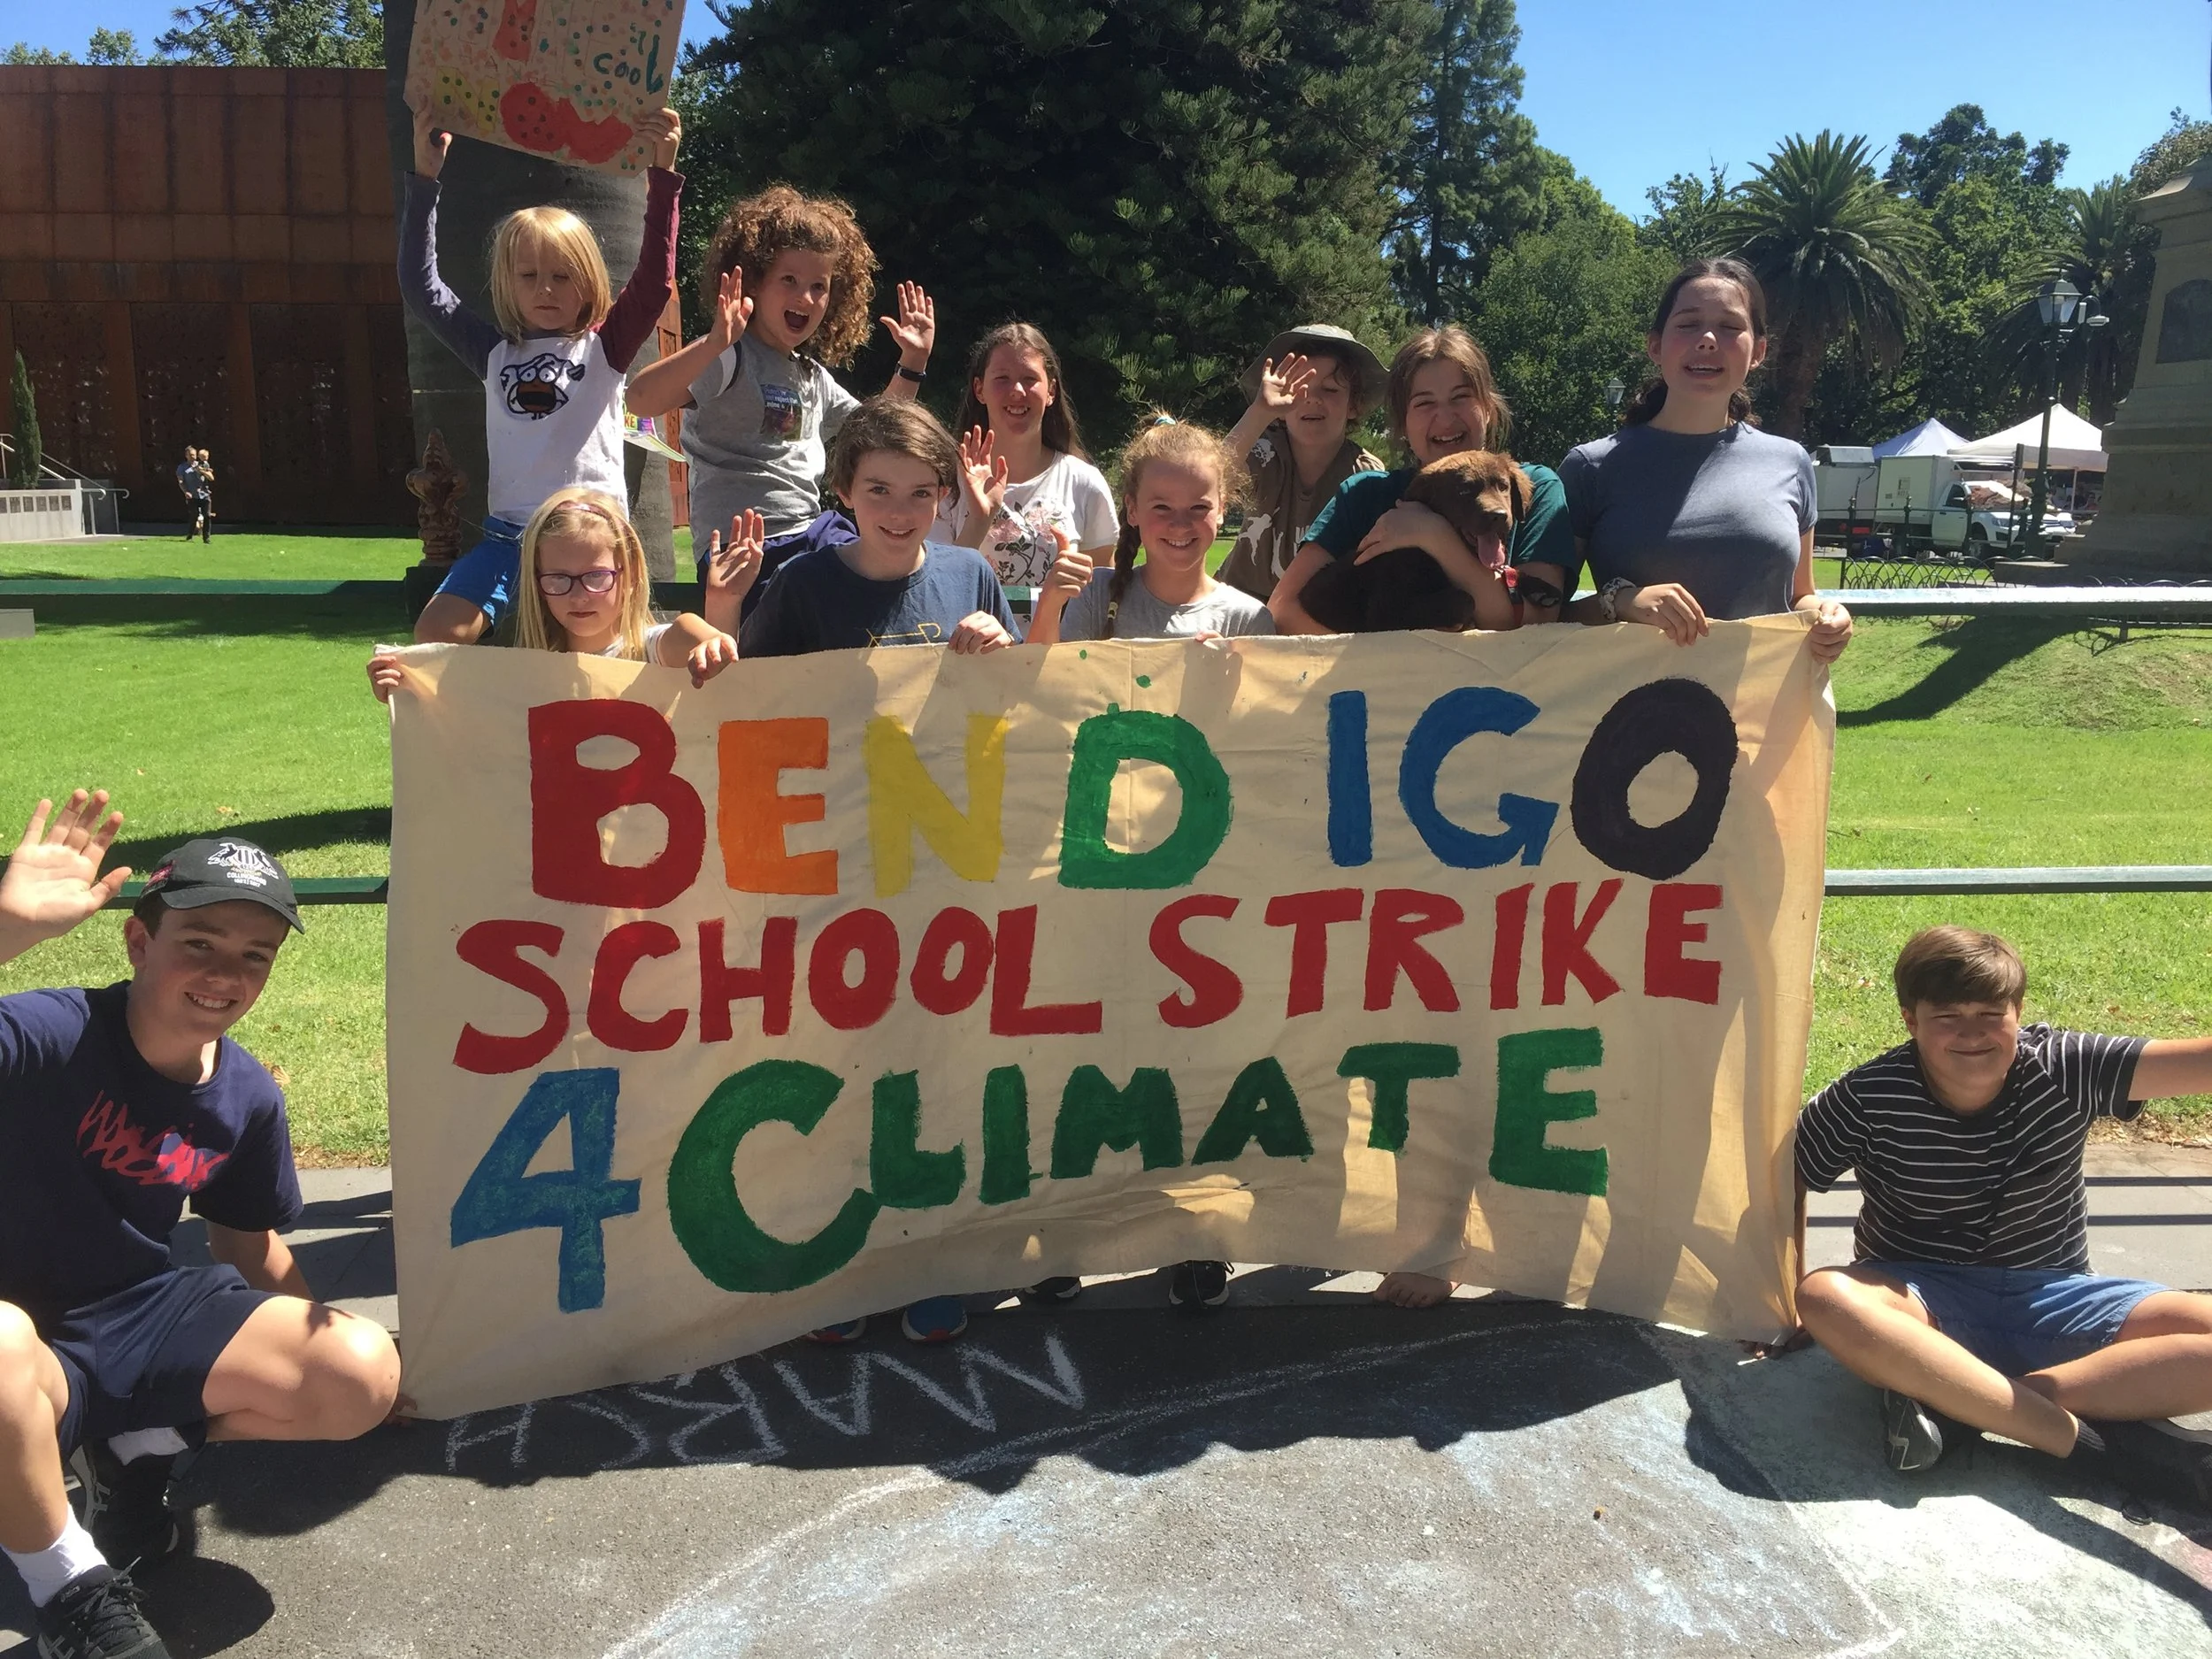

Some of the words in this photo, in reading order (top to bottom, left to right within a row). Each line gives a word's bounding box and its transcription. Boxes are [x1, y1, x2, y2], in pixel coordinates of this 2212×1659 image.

[452, 904, 1103, 1075] SCHOOL
[1148, 878, 1724, 1029] STRIKE
[450, 1067, 641, 1313] 4
[668, 1027, 1609, 1294] CLIMATE
